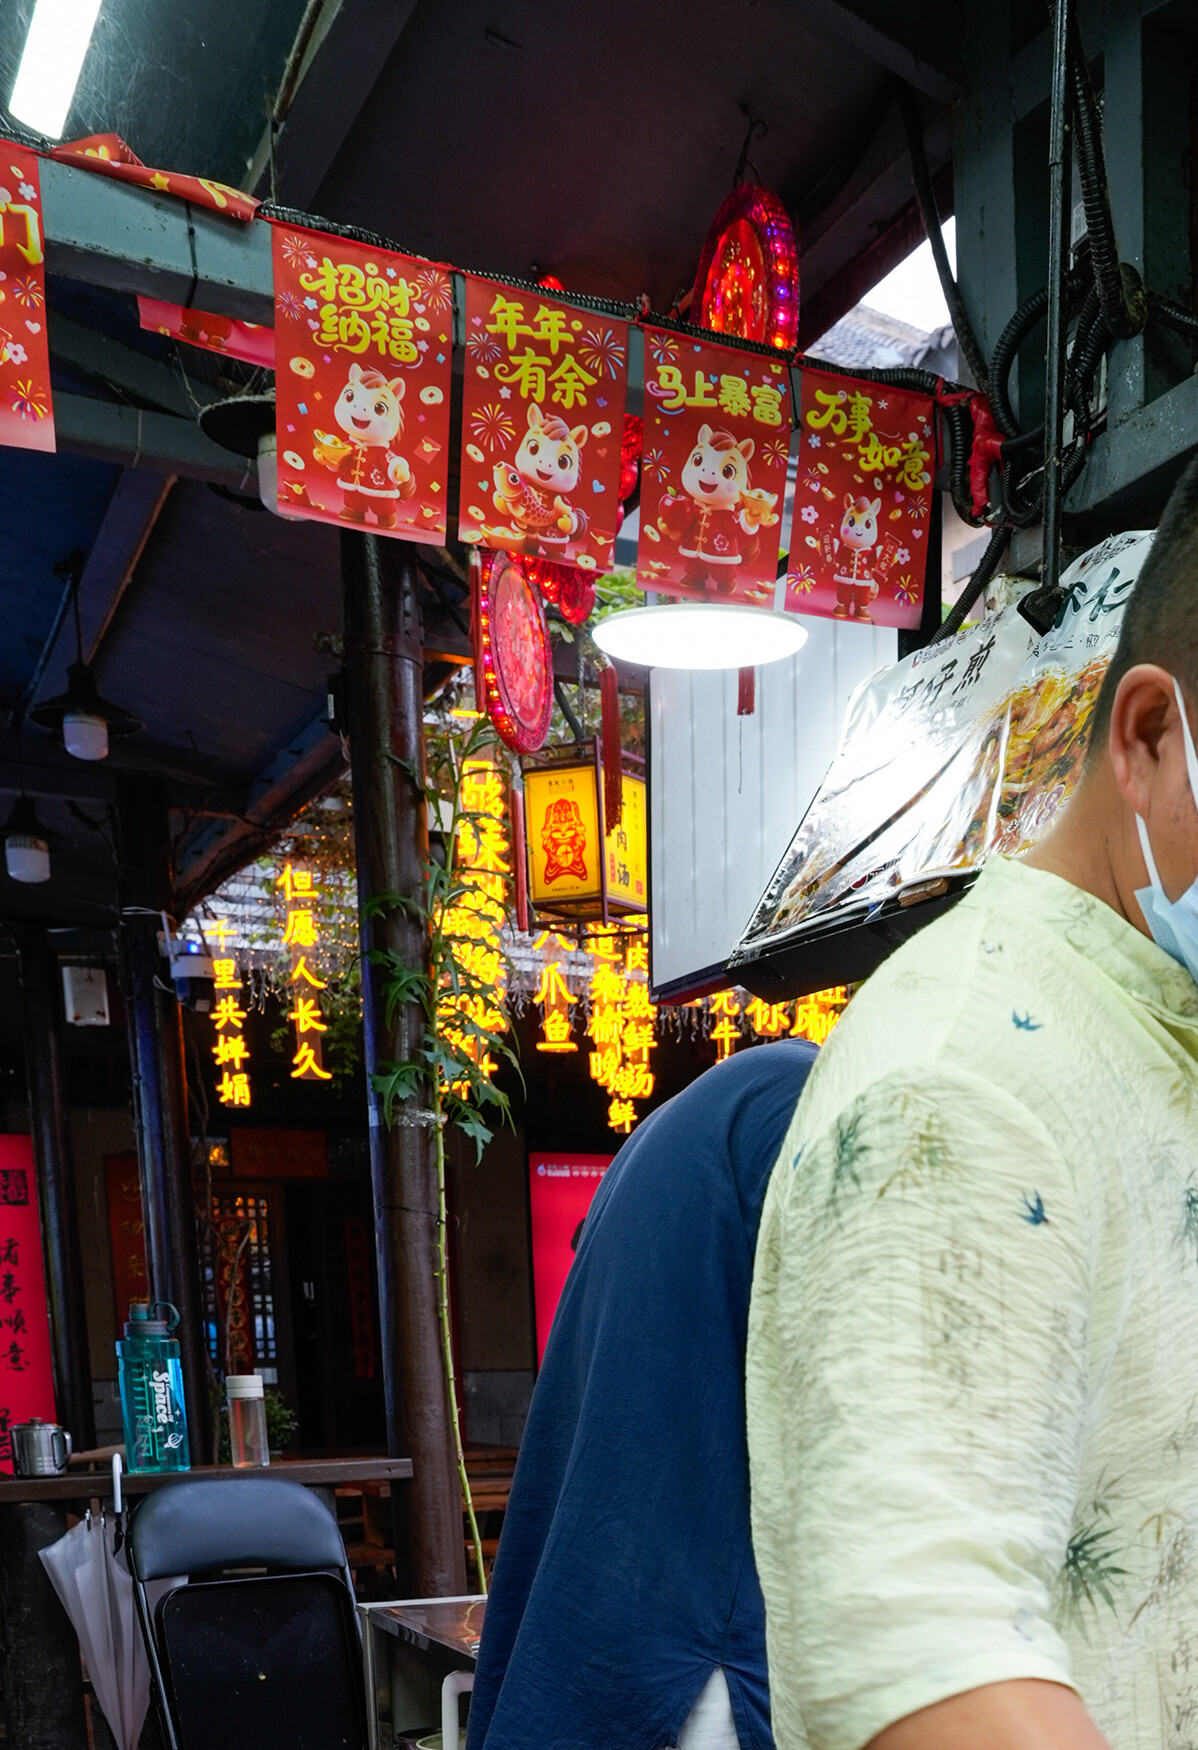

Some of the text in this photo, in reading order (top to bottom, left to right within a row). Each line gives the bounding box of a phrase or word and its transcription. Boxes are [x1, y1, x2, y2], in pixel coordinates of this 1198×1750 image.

[300, 257, 422, 318] 招财
[312, 303, 423, 363] 纳福
[485, 294, 575, 355] 年年
[493, 346, 598, 410] 有余
[656, 365, 783, 427] 马上暴富
[805, 389, 874, 443] 万事
[858, 432, 930, 491] 如意
[276, 862, 333, 1080] 但愿人长久
[203, 918, 251, 1106] 千里共婵娟
[148, 1370, 171, 1425] Space
